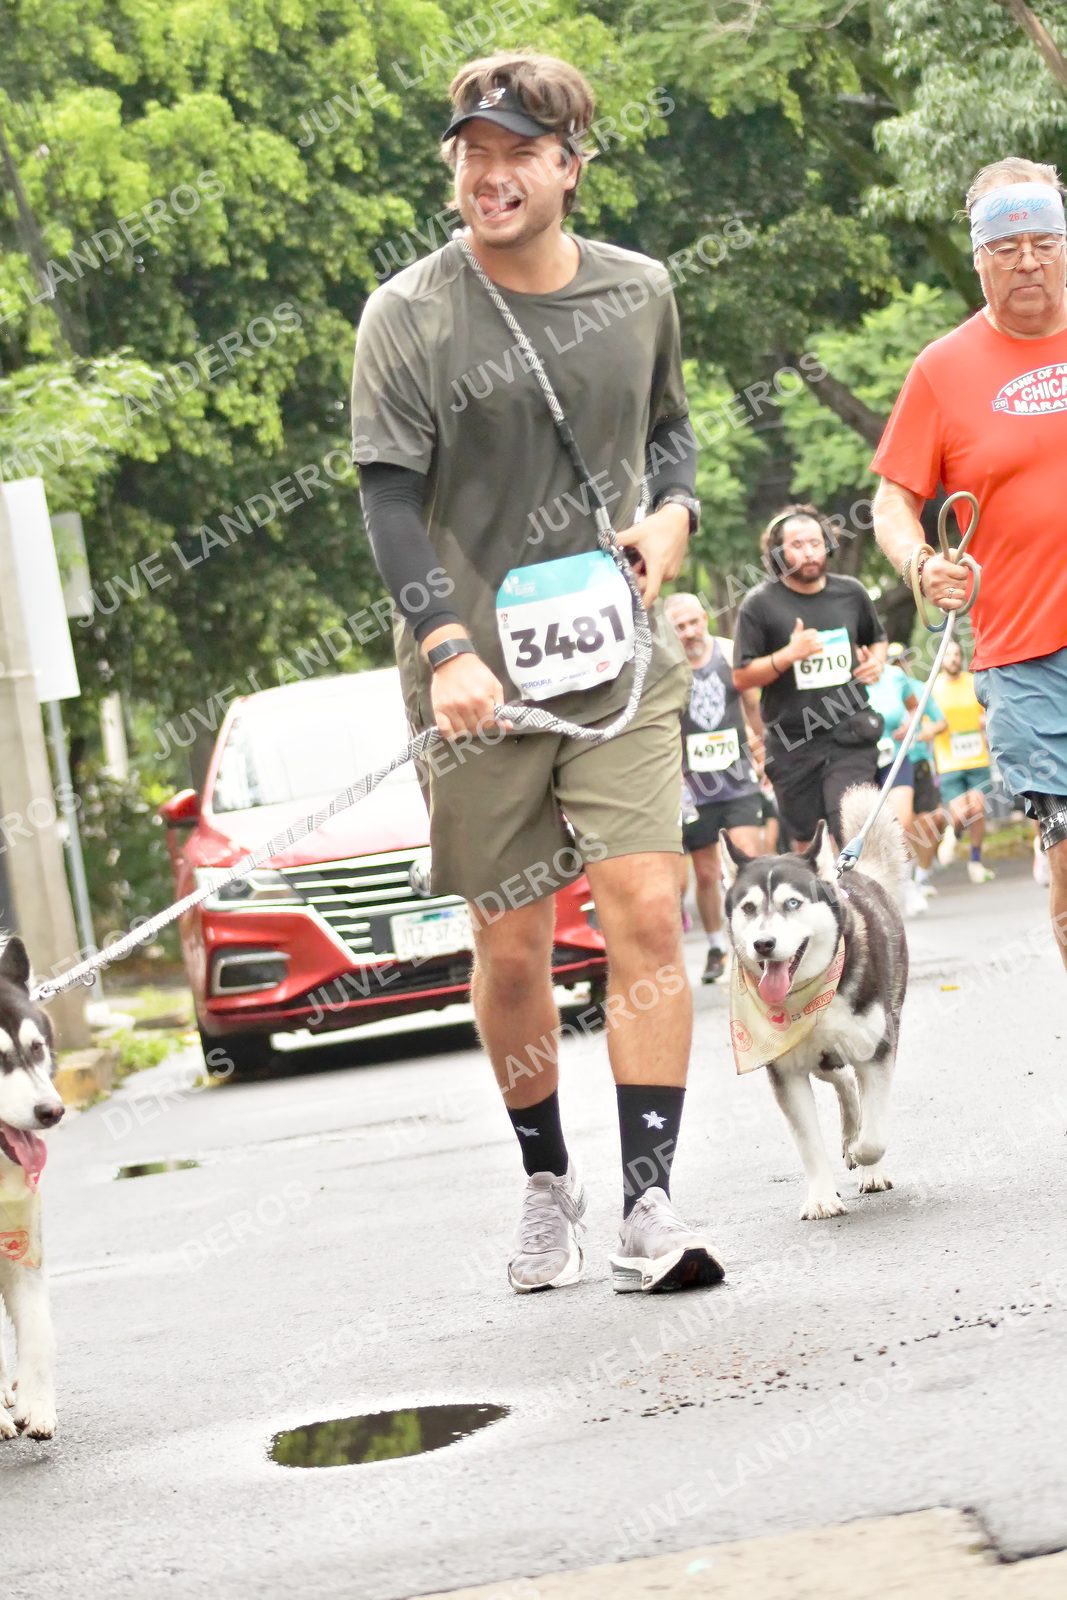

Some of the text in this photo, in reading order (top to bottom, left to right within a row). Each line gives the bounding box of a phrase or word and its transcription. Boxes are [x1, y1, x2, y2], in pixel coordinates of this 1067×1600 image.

[1008, 211, 1030, 222] 26.2
[1004, 374, 1037, 397] BANK
[1037, 368, 1053, 380] OF
[994, 401, 1006, 409] 20
[510, 604, 626, 668] 3481
[800, 654, 847, 675] 6710
[693, 741, 735, 757] 4970
